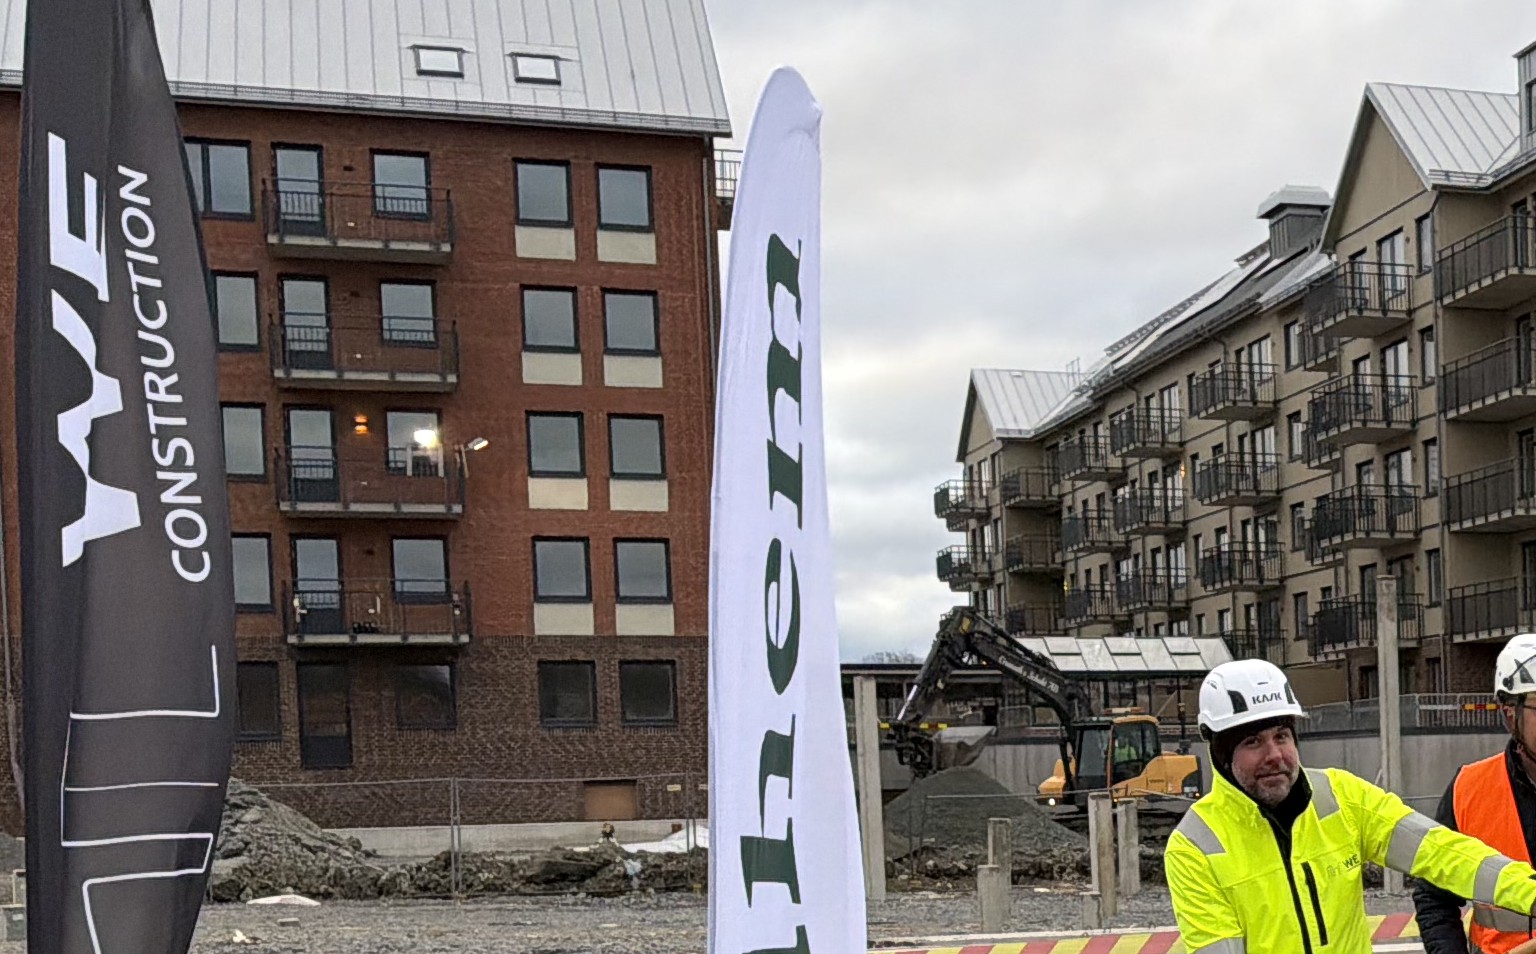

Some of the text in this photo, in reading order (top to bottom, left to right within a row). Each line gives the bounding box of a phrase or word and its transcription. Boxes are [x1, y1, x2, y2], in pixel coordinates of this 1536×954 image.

[47, 131, 141, 568] WE
[117, 164, 211, 583] CONSTRUCTION
[1341, 853, 1361, 869] WE
